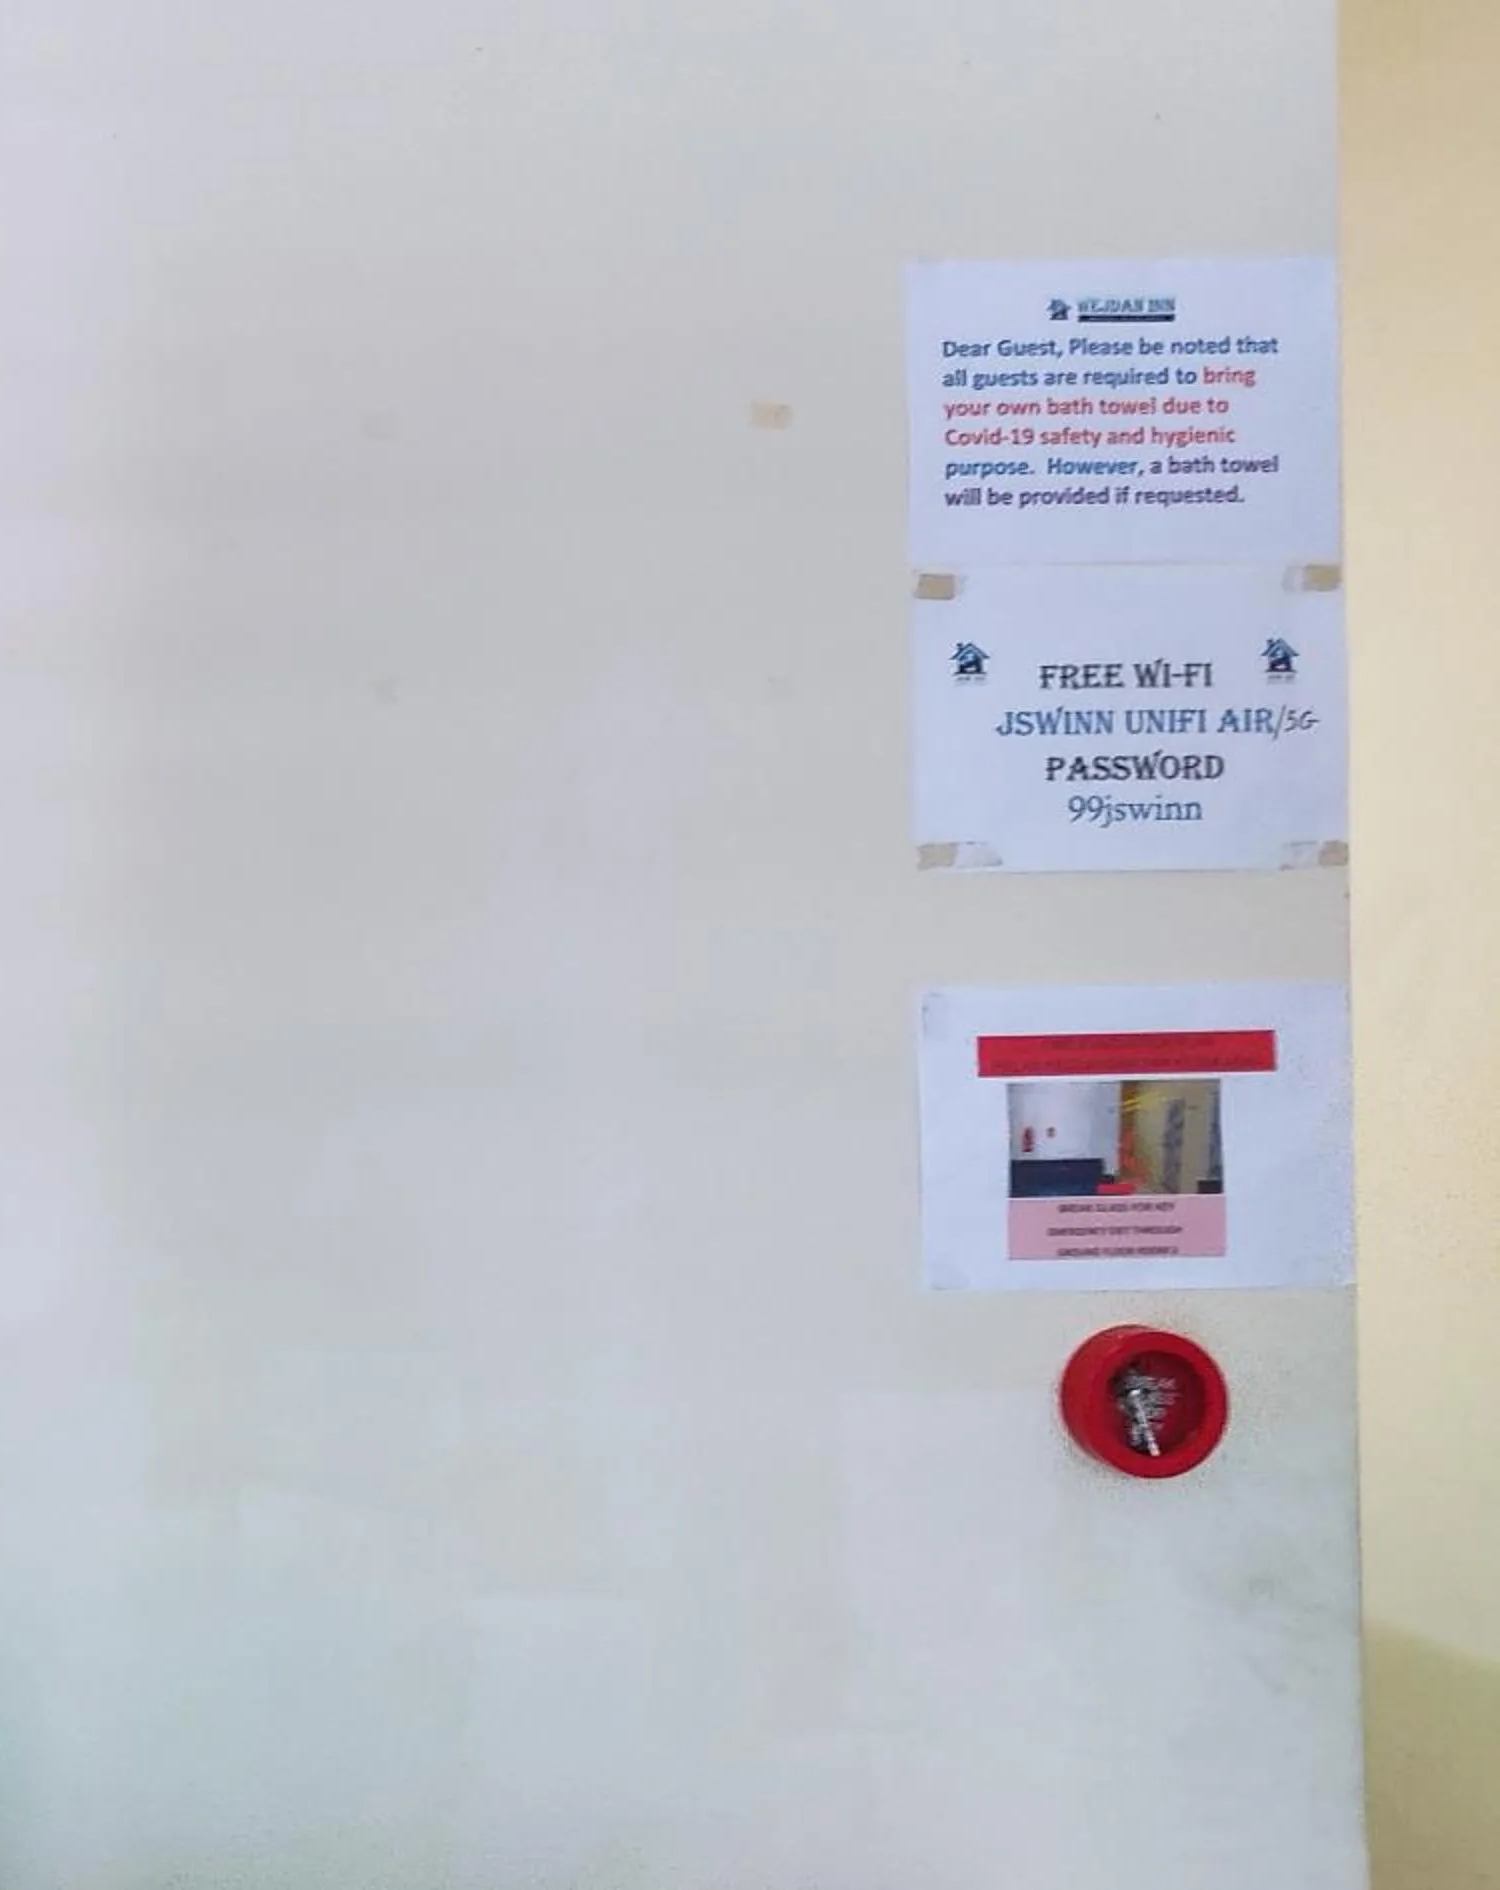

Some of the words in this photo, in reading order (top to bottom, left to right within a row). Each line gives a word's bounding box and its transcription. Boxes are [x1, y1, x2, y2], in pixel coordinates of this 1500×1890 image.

[942, 340, 992, 358] Dear
[997, 339, 1064, 359] Guest,
[1069, 338, 1134, 357] Please
[1139, 337, 1165, 356] be
[1170, 336, 1231, 355] noted
[1236, 335, 1279, 354] that
[942, 369, 968, 387] all
[972, 369, 1040, 391] guests
[1044, 371, 1078, 387] are
[1083, 367, 1170, 390] required
[1175, 368, 1198, 385] to
[1203, 366, 1257, 388] bring
[943, 402, 991, 419] your
[996, 401, 1041, 417] own
[1046, 397, 1094, 416] bath
[1099, 396, 1157, 415] towel
[1162, 396, 1201, 415] due
[1208, 397, 1230, 414] to
[945, 427, 1035, 447] Covid-19
[1039, 426, 1103, 449] safety
[1107, 426, 1146, 445] and
[1151, 425, 1237, 449] hygienic
[944, 461, 1036, 480] purpose.
[1047, 456, 1145, 477] However,
[1149, 460, 1163, 475] a
[1168, 455, 1216, 474] bath
[1220, 454, 1280, 474] towel
[944, 487, 983, 507] will
[987, 486, 1014, 507] be
[1018, 485, 1111, 510] provided
[1115, 485, 1131, 505] if
[1135, 484, 1246, 509] requested.
[1038, 662, 1126, 690] FREE
[1132, 657, 1214, 689] WI-FI
[996, 705, 1115, 737] JSWINN
[1124, 708, 1207, 735] UNIFI
[1044, 749, 1226, 782] PASSWORD
[1067, 795, 1203, 829] 99jswinn
